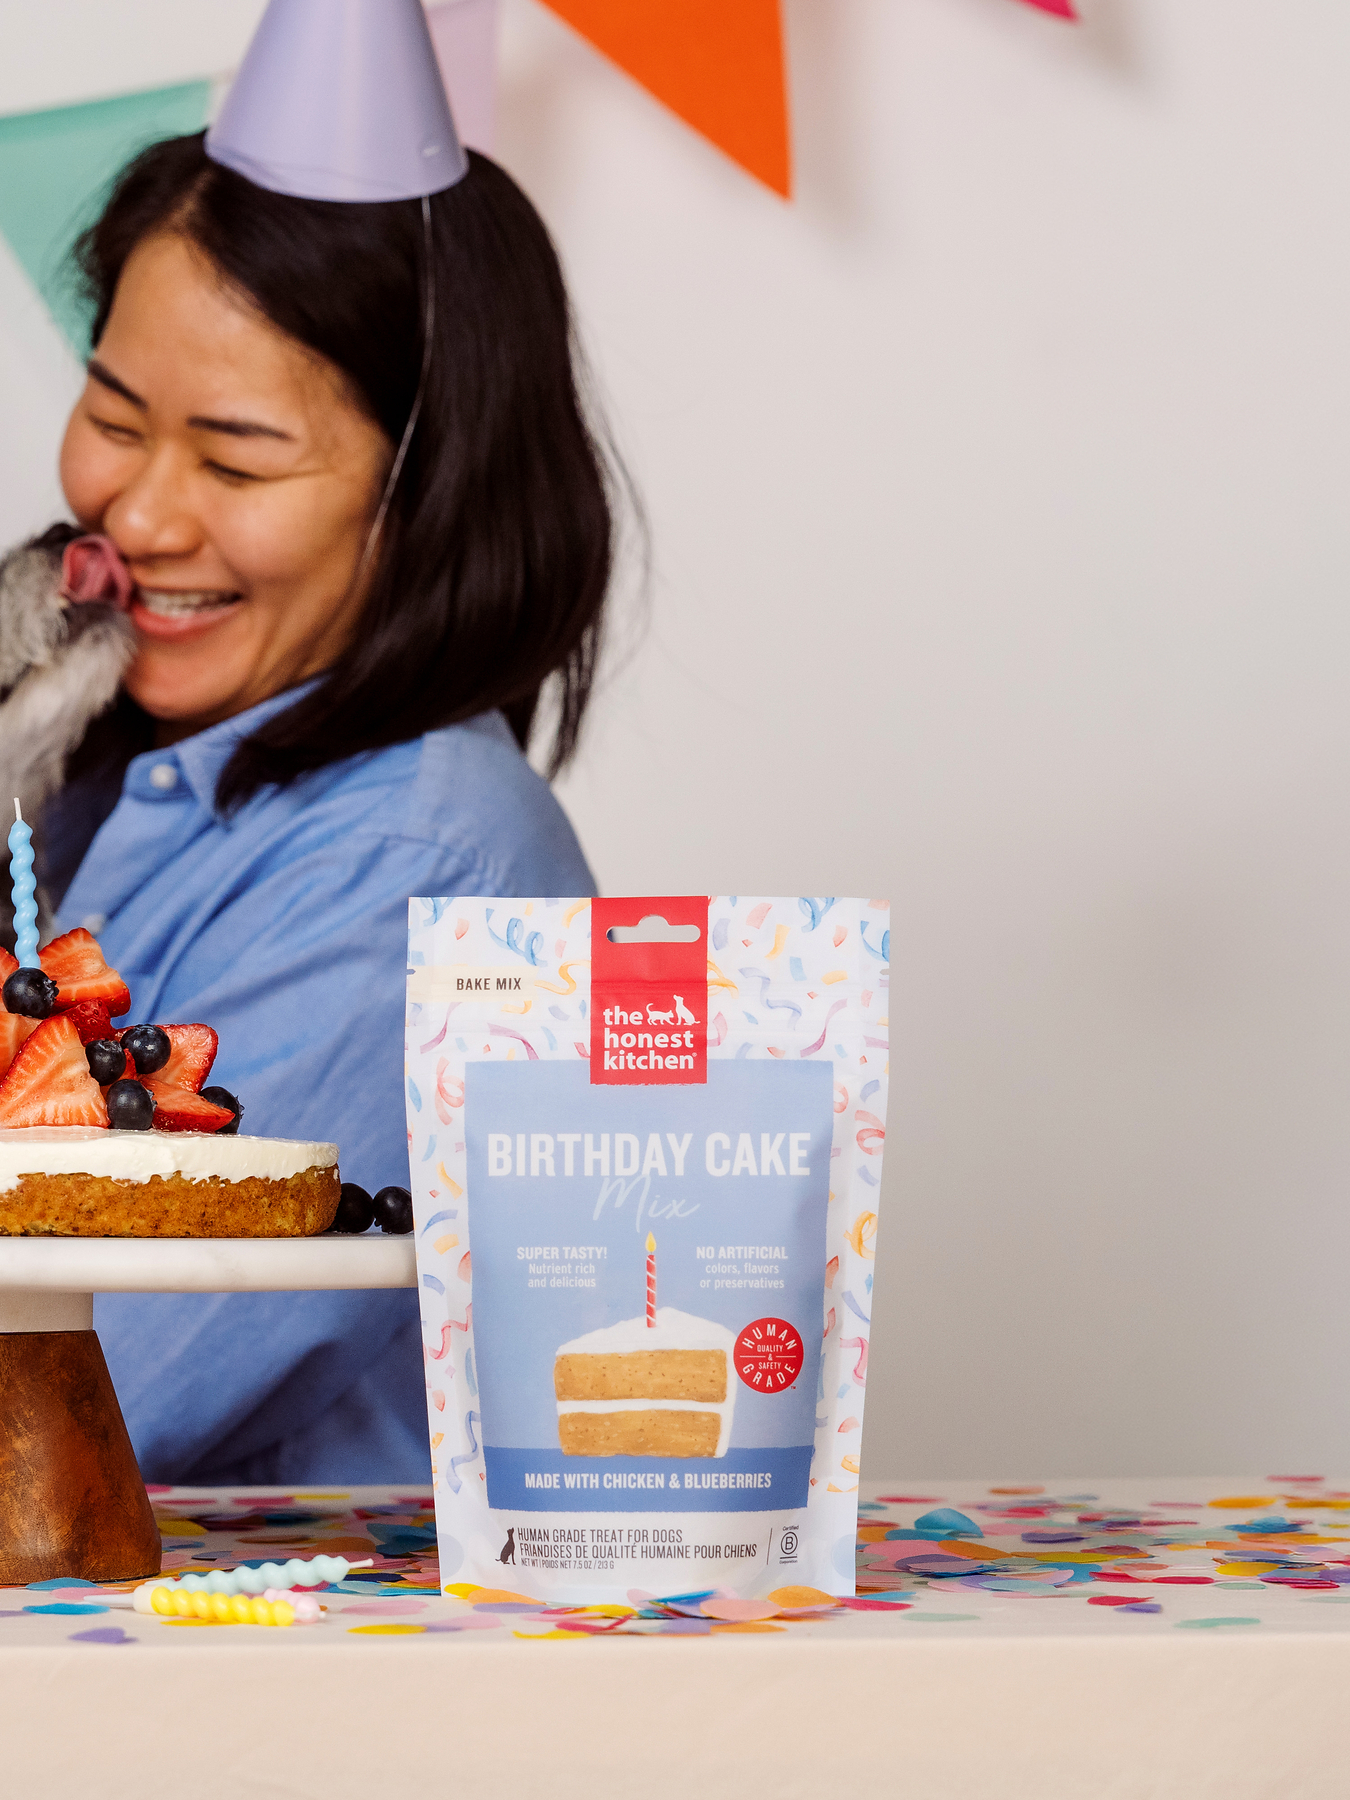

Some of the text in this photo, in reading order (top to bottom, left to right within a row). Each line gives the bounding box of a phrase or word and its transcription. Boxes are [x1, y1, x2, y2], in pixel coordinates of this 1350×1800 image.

[456, 977, 522, 991] BAKE MIX
[603, 1005, 643, 1025] the
[604, 1028, 694, 1048] honest
[604, 1049, 694, 1070] kitchen
[488, 1132, 811, 1177] BIRTHDAY CAKE
[592, 1175, 702, 1233] Mix
[516, 1246, 608, 1260] SUPER TASTY!
[696, 1246, 789, 1259] NO ARTIFICIAL
[528, 1263, 595, 1274] Nutrient rich
[705, 1262, 779, 1275] colors, flavors
[528, 1276, 596, 1288] and delicious
[699, 1277, 785, 1290] or preservatives
[742, 1324, 797, 1350] HUMAN
[756, 1344, 783, 1352] QUALITY
[767, 1353, 773, 1361] &
[758, 1361, 781, 1369] SAFETY
[742, 1363, 796, 1388] GRADE
[525, 1472, 772, 1489] MADE WITH CHICKEN & BLUEBERRIES
[518, 1527, 683, 1543] HUMAN GRADE TREAT FOR DOGS
[520, 1543, 757, 1559] FRIANDISES DE QUALITÉ HUMAINE POUR CHIENS
[521, 1558, 531, 1566] NET
[531, 1559, 539, 1567] WT
[542, 1560, 559, 1569] POIDS
[560, 1560, 571, 1569] NET
[573, 1560, 583, 1569] 7.5
[584, 1560, 592, 1569] OZ
[598, 1560, 608, 1569] 213
